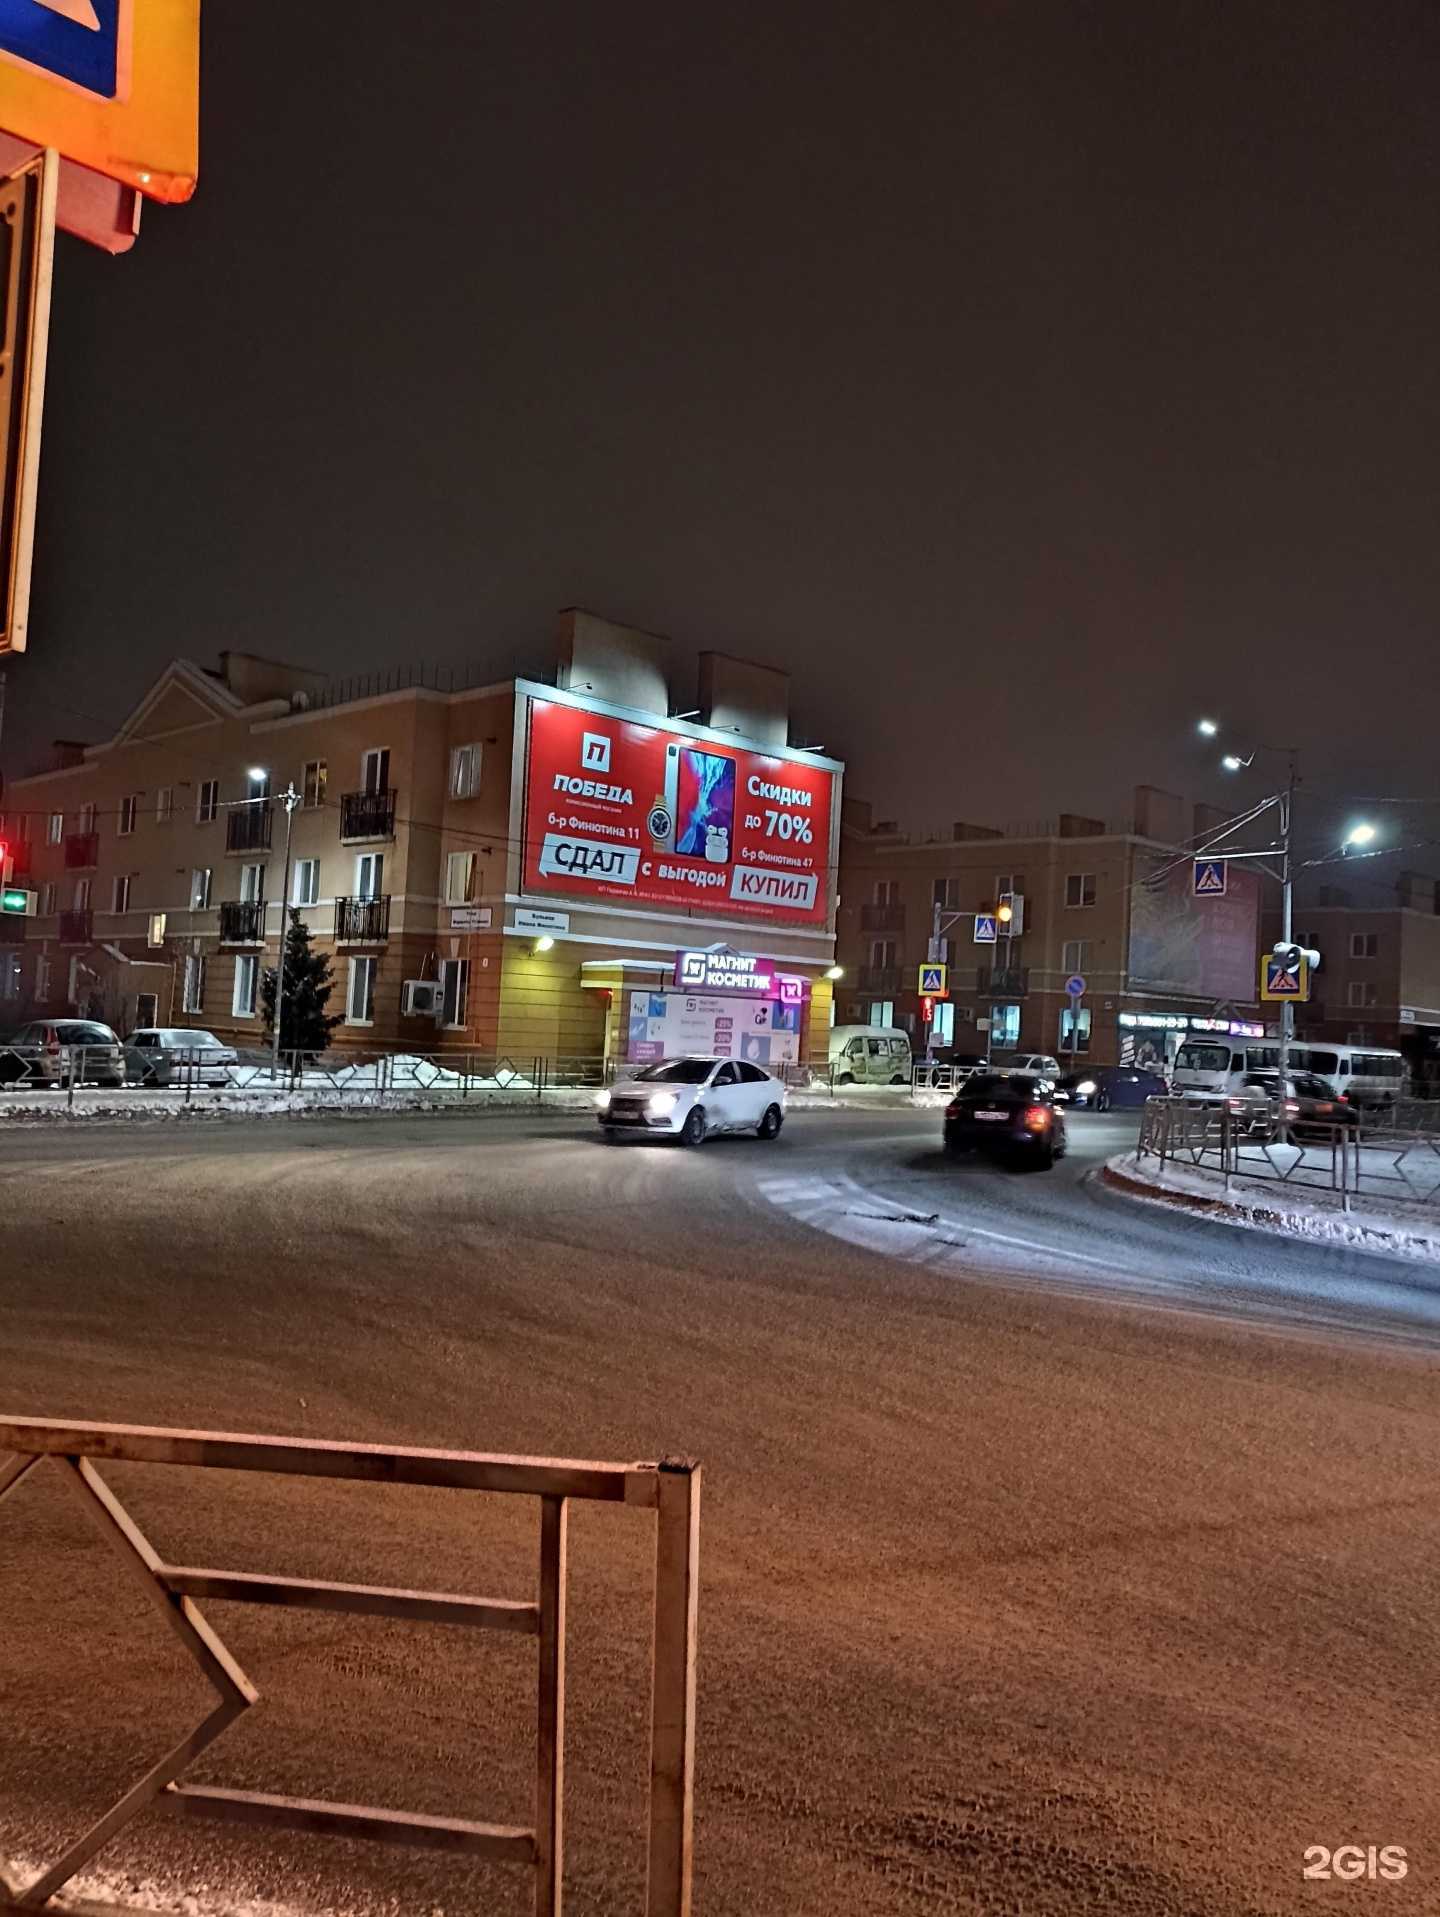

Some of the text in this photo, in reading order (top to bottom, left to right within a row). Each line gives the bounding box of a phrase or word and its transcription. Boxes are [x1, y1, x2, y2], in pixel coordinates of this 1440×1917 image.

[553, 774, 633, 804] ПОБЕДА
[747, 775, 812, 807] Скидки
[569, 816, 626, 838] Финютина
[628, 827, 640, 840] 11
[744, 809, 813, 844] до 70%
[555, 843, 625, 875] СДАЛ
[740, 873, 809, 901] КУПИЛ
[708, 954, 757, 972] МАГНИТ
[707, 971, 771, 990] КОСМЕТИК
